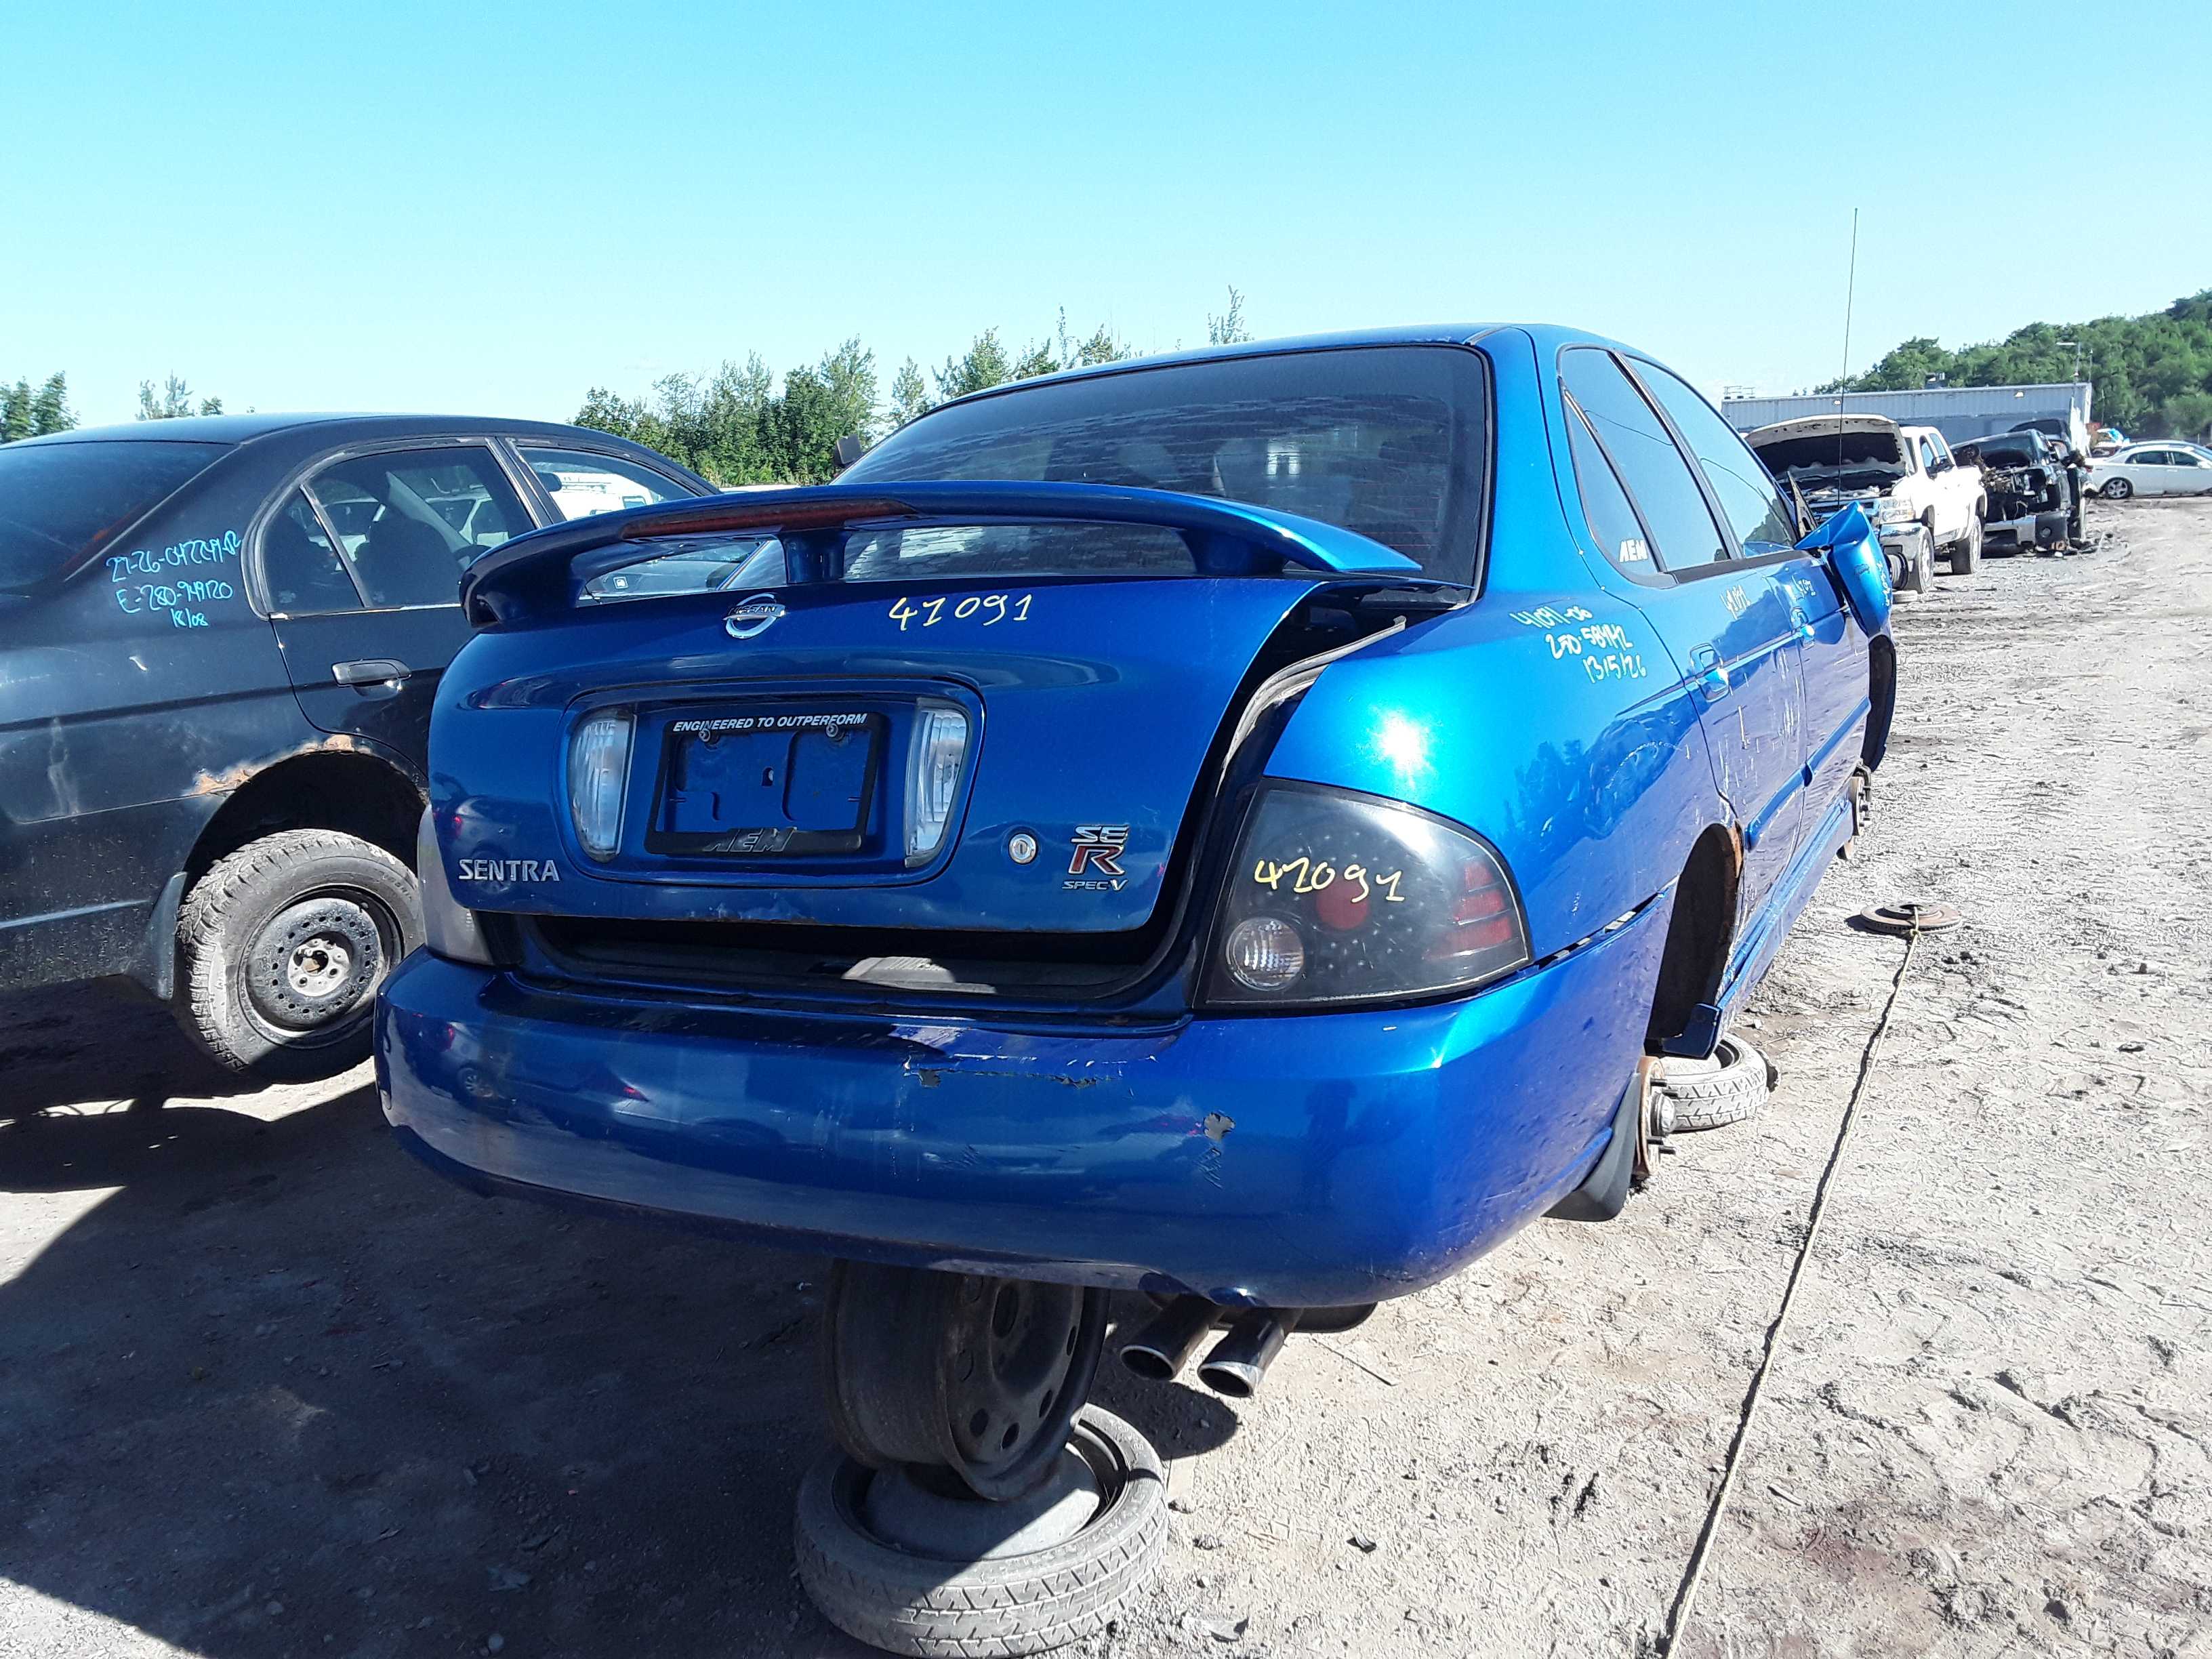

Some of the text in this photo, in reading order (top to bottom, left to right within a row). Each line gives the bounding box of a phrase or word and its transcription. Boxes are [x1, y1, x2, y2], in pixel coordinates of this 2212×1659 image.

[673, 713, 867, 732] ENGINEERED TO OUTPERFORM
[1071, 824, 1130, 844] SE
[1068, 844, 1126, 875] R
[458, 859, 560, 882] SENTRA
[1061, 879, 1128, 892] SPEC V
